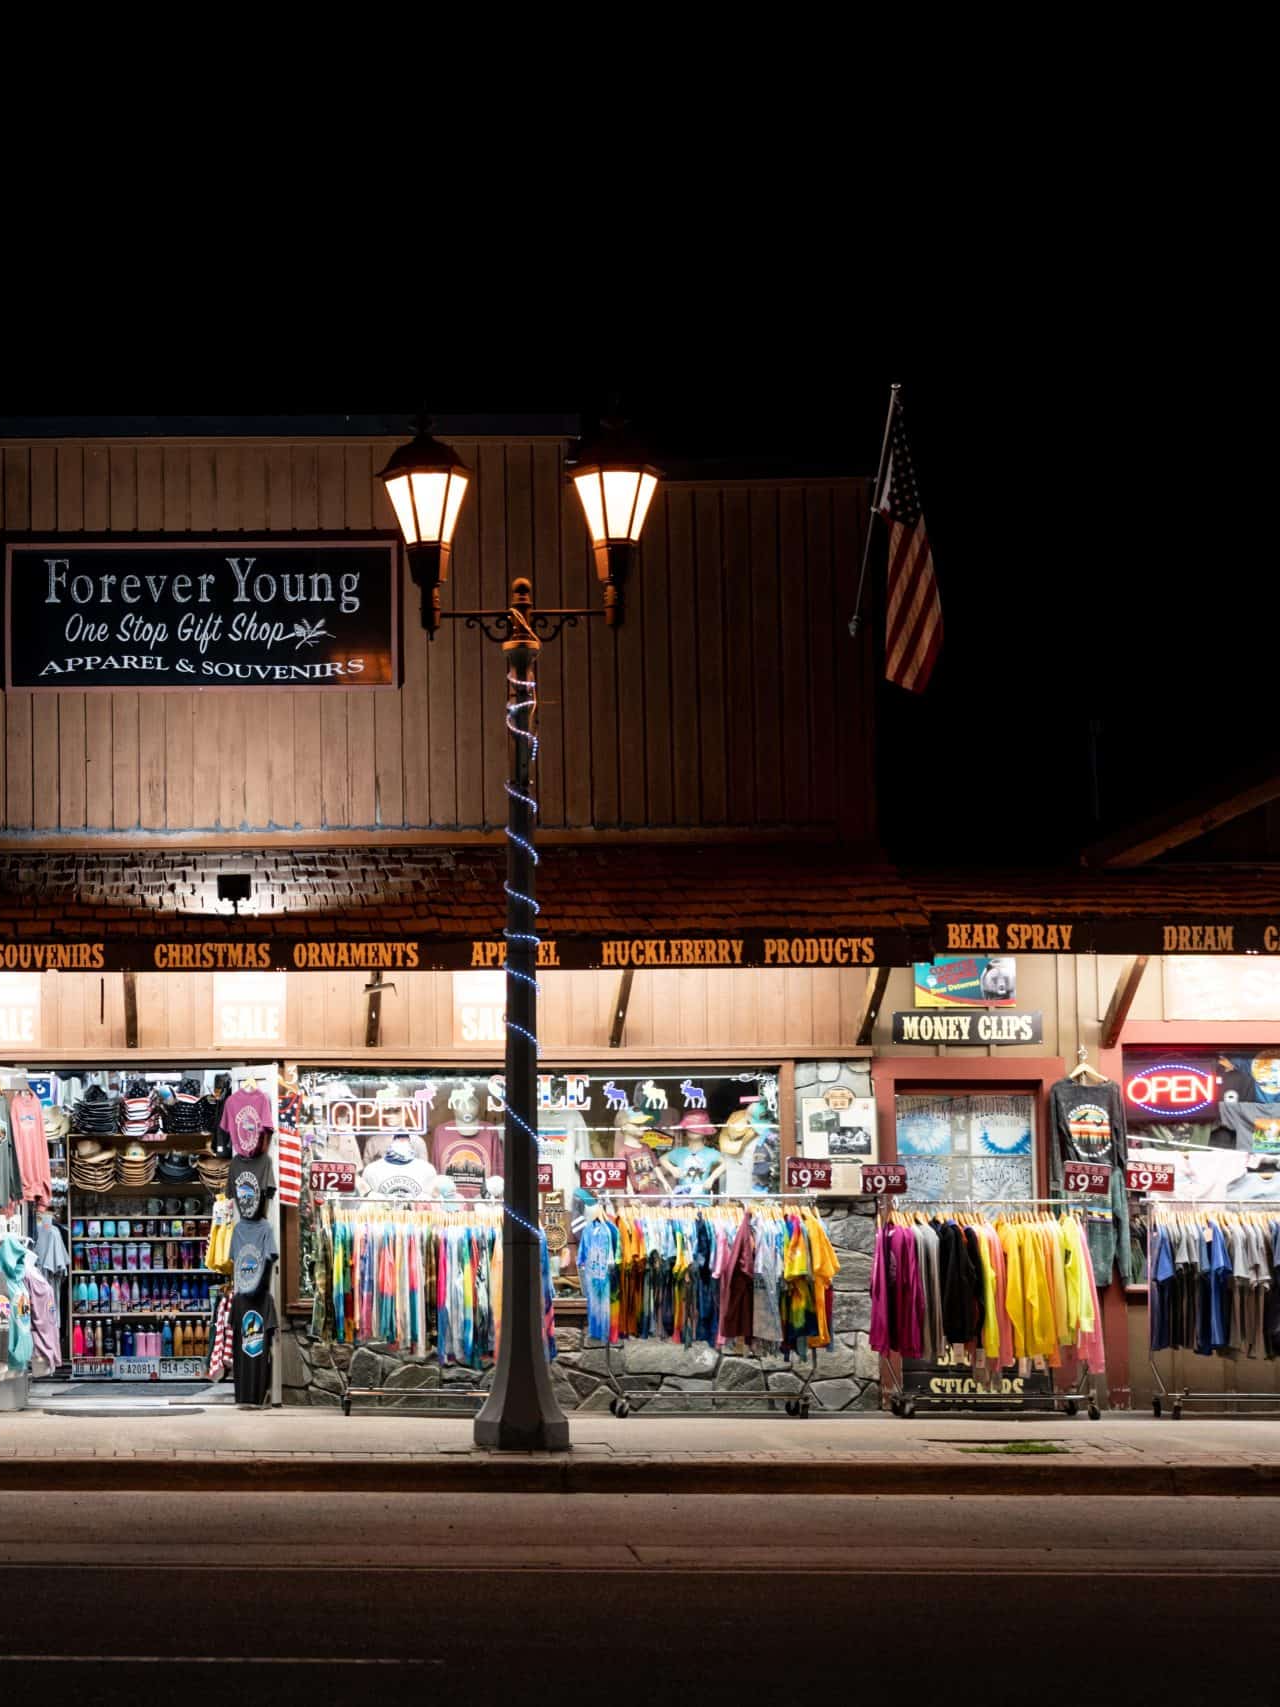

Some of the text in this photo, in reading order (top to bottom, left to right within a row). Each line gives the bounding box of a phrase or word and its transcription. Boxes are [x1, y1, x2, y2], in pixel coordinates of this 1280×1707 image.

[44, 557, 361, 614] Forever Young
[64, 611, 286, 654] One Stop Gift Shop
[39, 654, 365, 680] APPAREL & SOUVENIRS
[947, 924, 1072, 950] BEAR SPRAY
[1163, 926, 1234, 951] DREAM
[154, 942, 419, 968] CHRISTMAS ORNAMENTS
[471, 941, 560, 967] APPEL
[601, 938, 876, 966] HUCKLEBERRY PRODUCTS
[902, 1015, 1034, 1041] MONEY CLIPS
[488, 1075, 591, 1112] SLE
[1126, 1077, 1216, 1105] OPEN
[331, 1101, 424, 1131] OPEN
